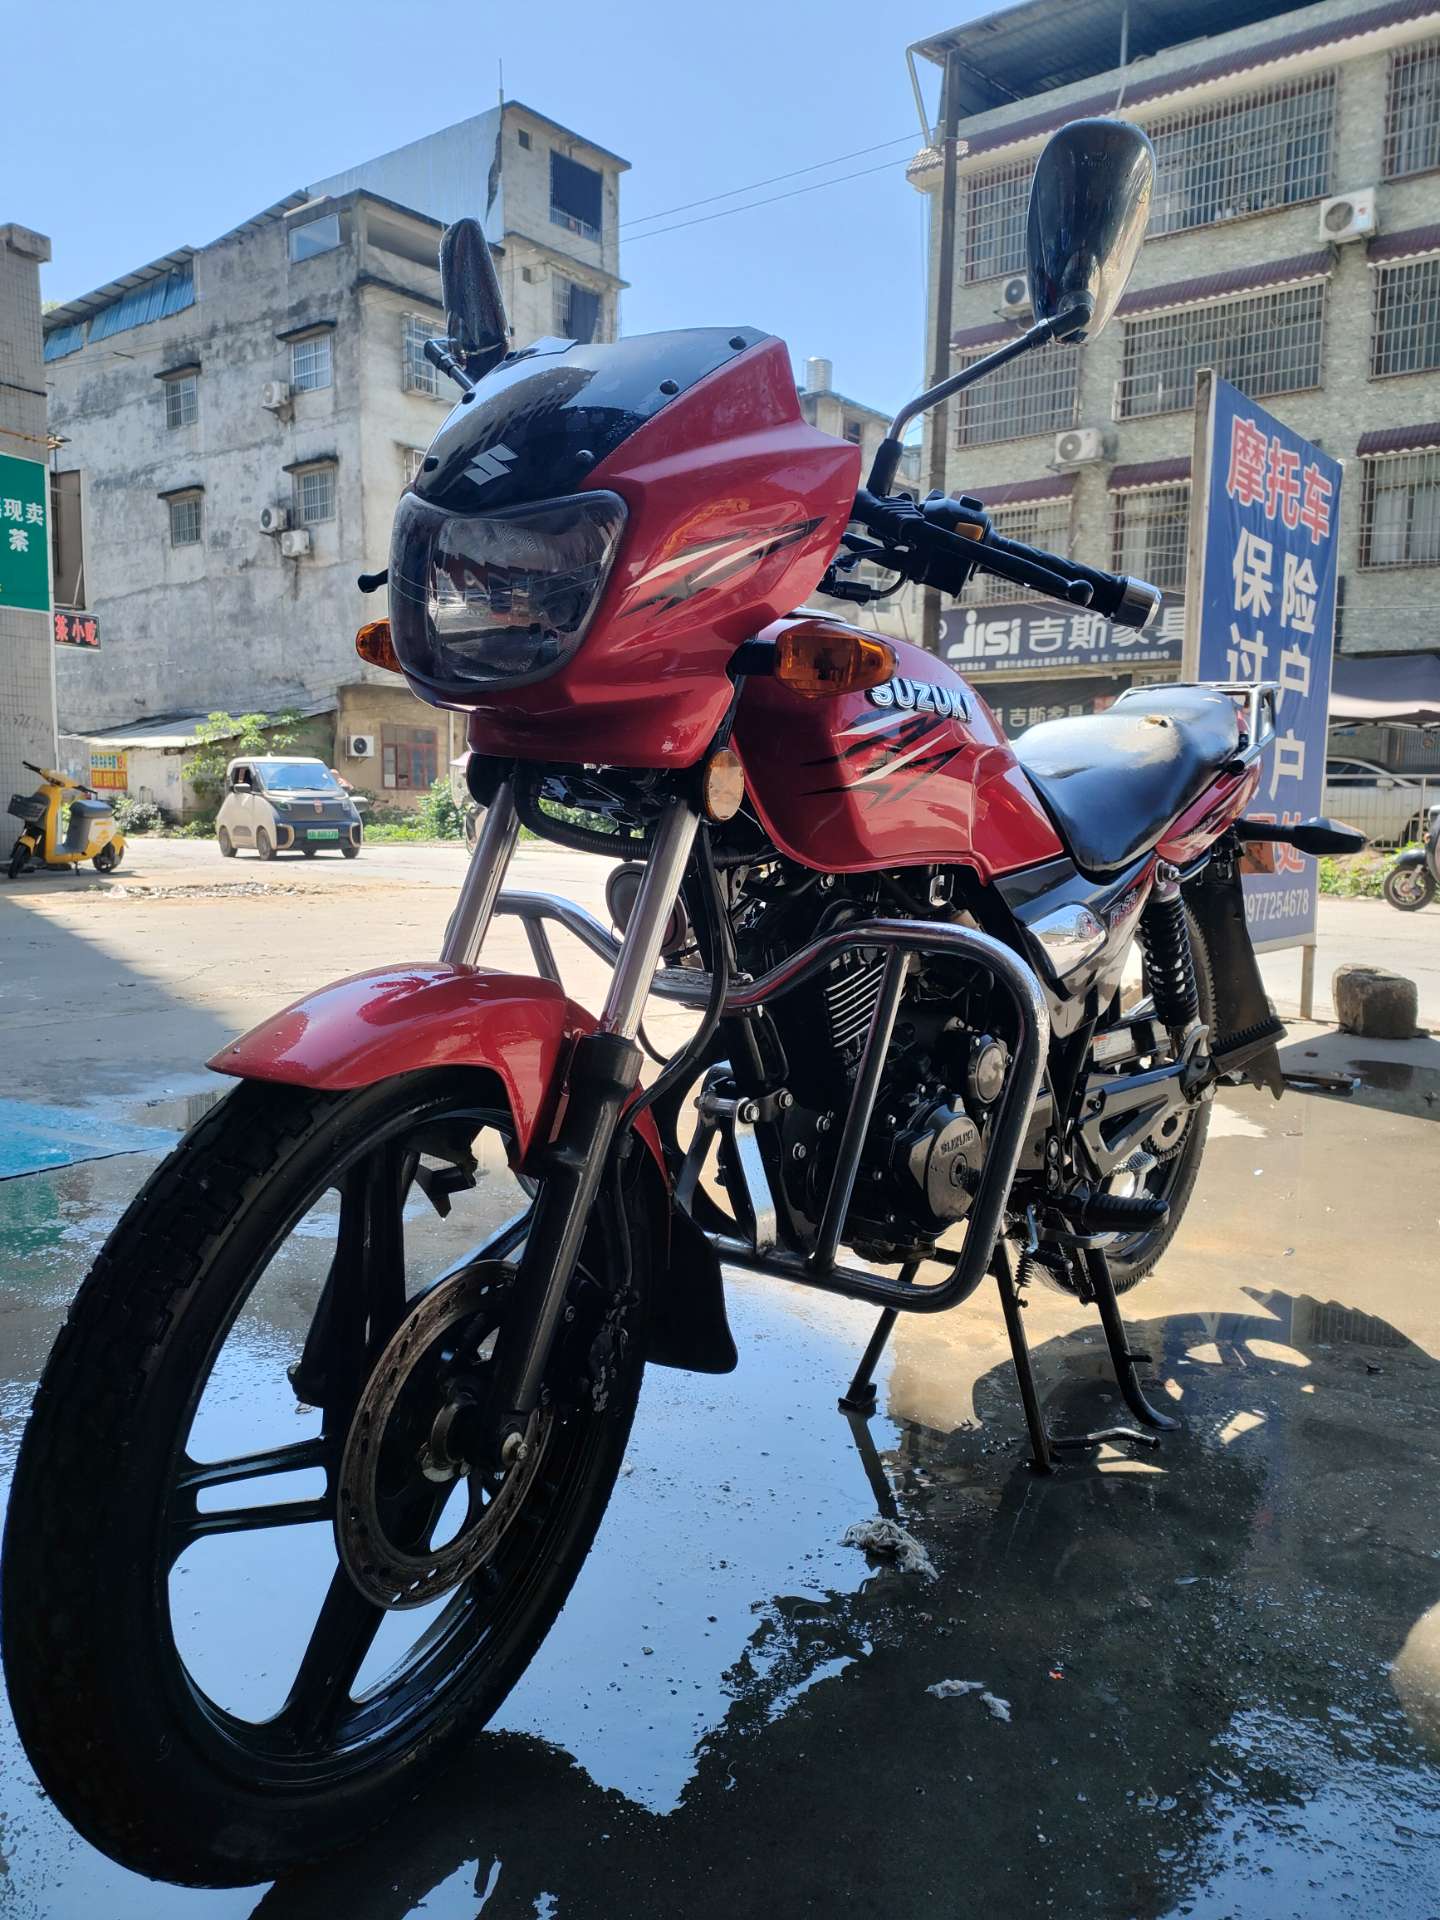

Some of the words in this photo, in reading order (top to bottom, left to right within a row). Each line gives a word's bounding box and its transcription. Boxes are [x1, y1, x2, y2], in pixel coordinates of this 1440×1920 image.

[0, 498, 44, 527] 现卖
[1226, 414, 1332, 545] 摩托车
[1232, 527, 1318, 634] 保险
[867, 676, 972, 722] SUZUKI
